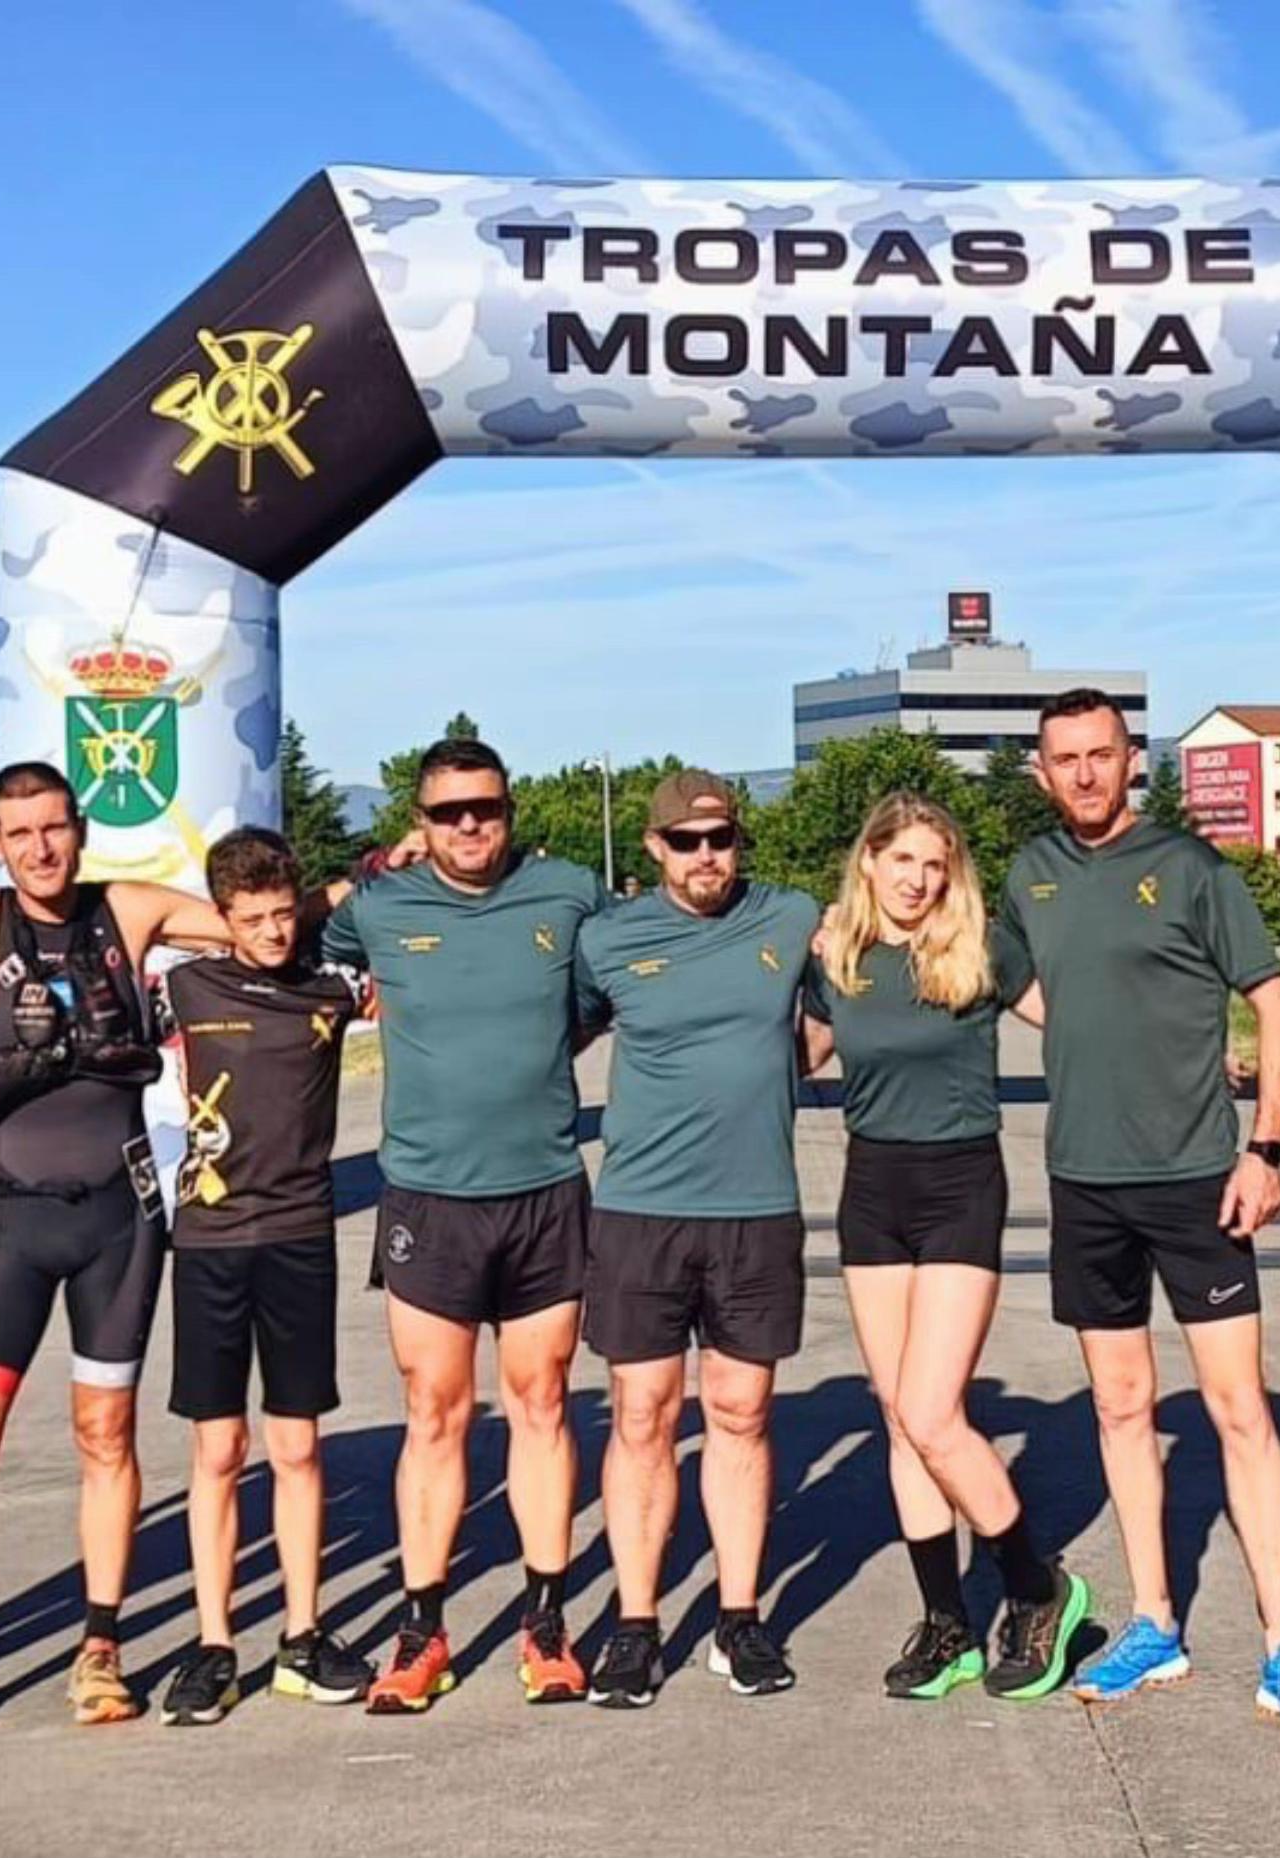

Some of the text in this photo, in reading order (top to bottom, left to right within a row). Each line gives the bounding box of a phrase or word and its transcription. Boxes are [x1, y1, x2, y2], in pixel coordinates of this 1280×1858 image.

[498, 225, 1254, 285] TROPAS DE
[547, 296, 1212, 377] MONTAÑA
